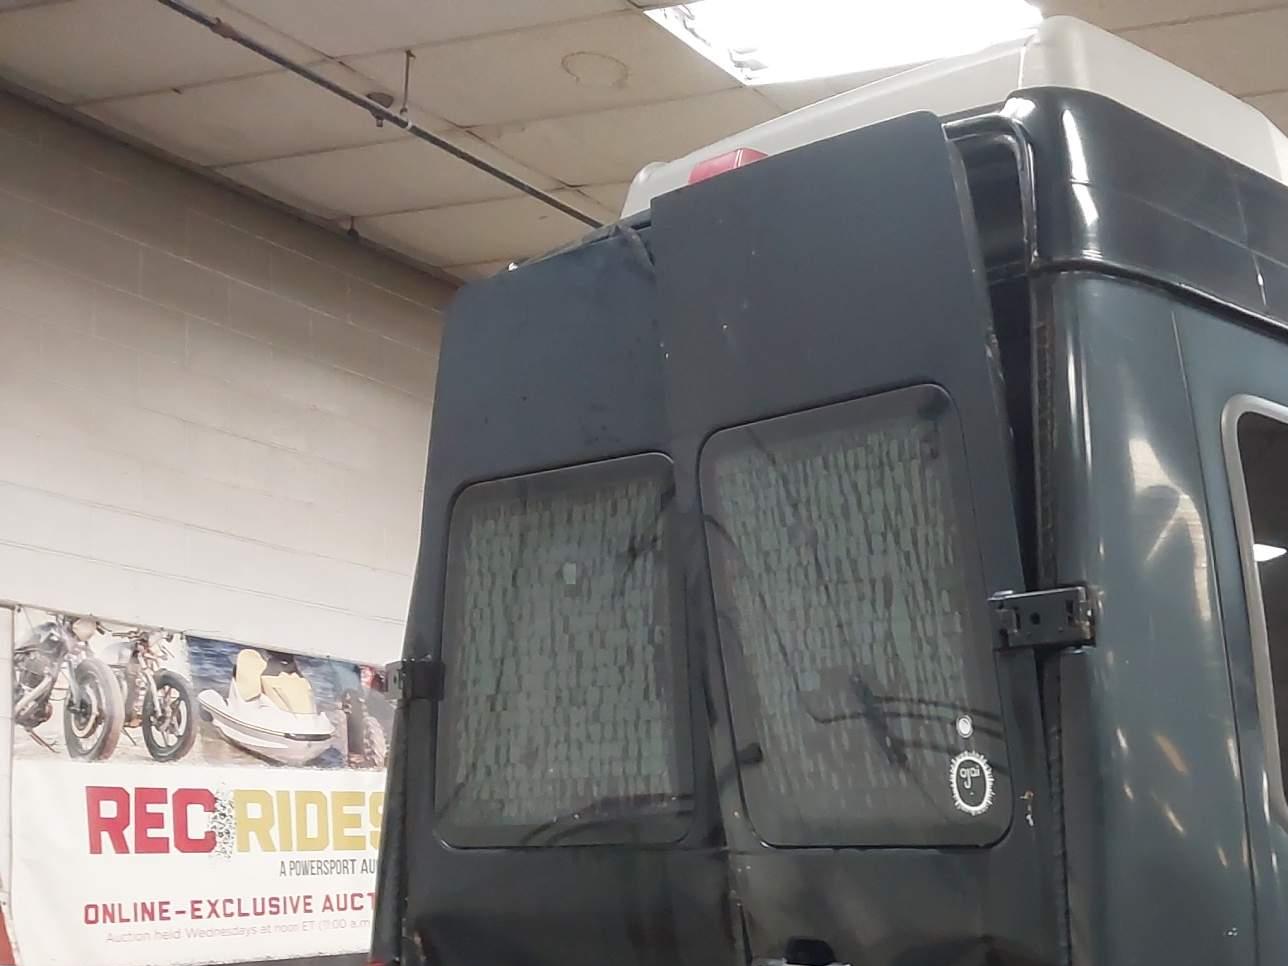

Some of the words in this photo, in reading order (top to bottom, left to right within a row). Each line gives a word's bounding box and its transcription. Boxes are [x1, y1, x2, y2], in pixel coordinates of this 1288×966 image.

[86, 786, 217, 855] REC
[279, 860, 287, 877] A
[289, 859, 357, 877] POWERSPORT
[84, 894, 313, 925] ONLINE-EXCLUSIVE
[105, 931, 151, 944] Auction
[154, 927, 181, 941] held
[185, 924, 257, 939] Wednesdays
[261, 924, 272, 934] at
[275, 922, 299, 933] noon
[302, 920, 316, 931] ET
